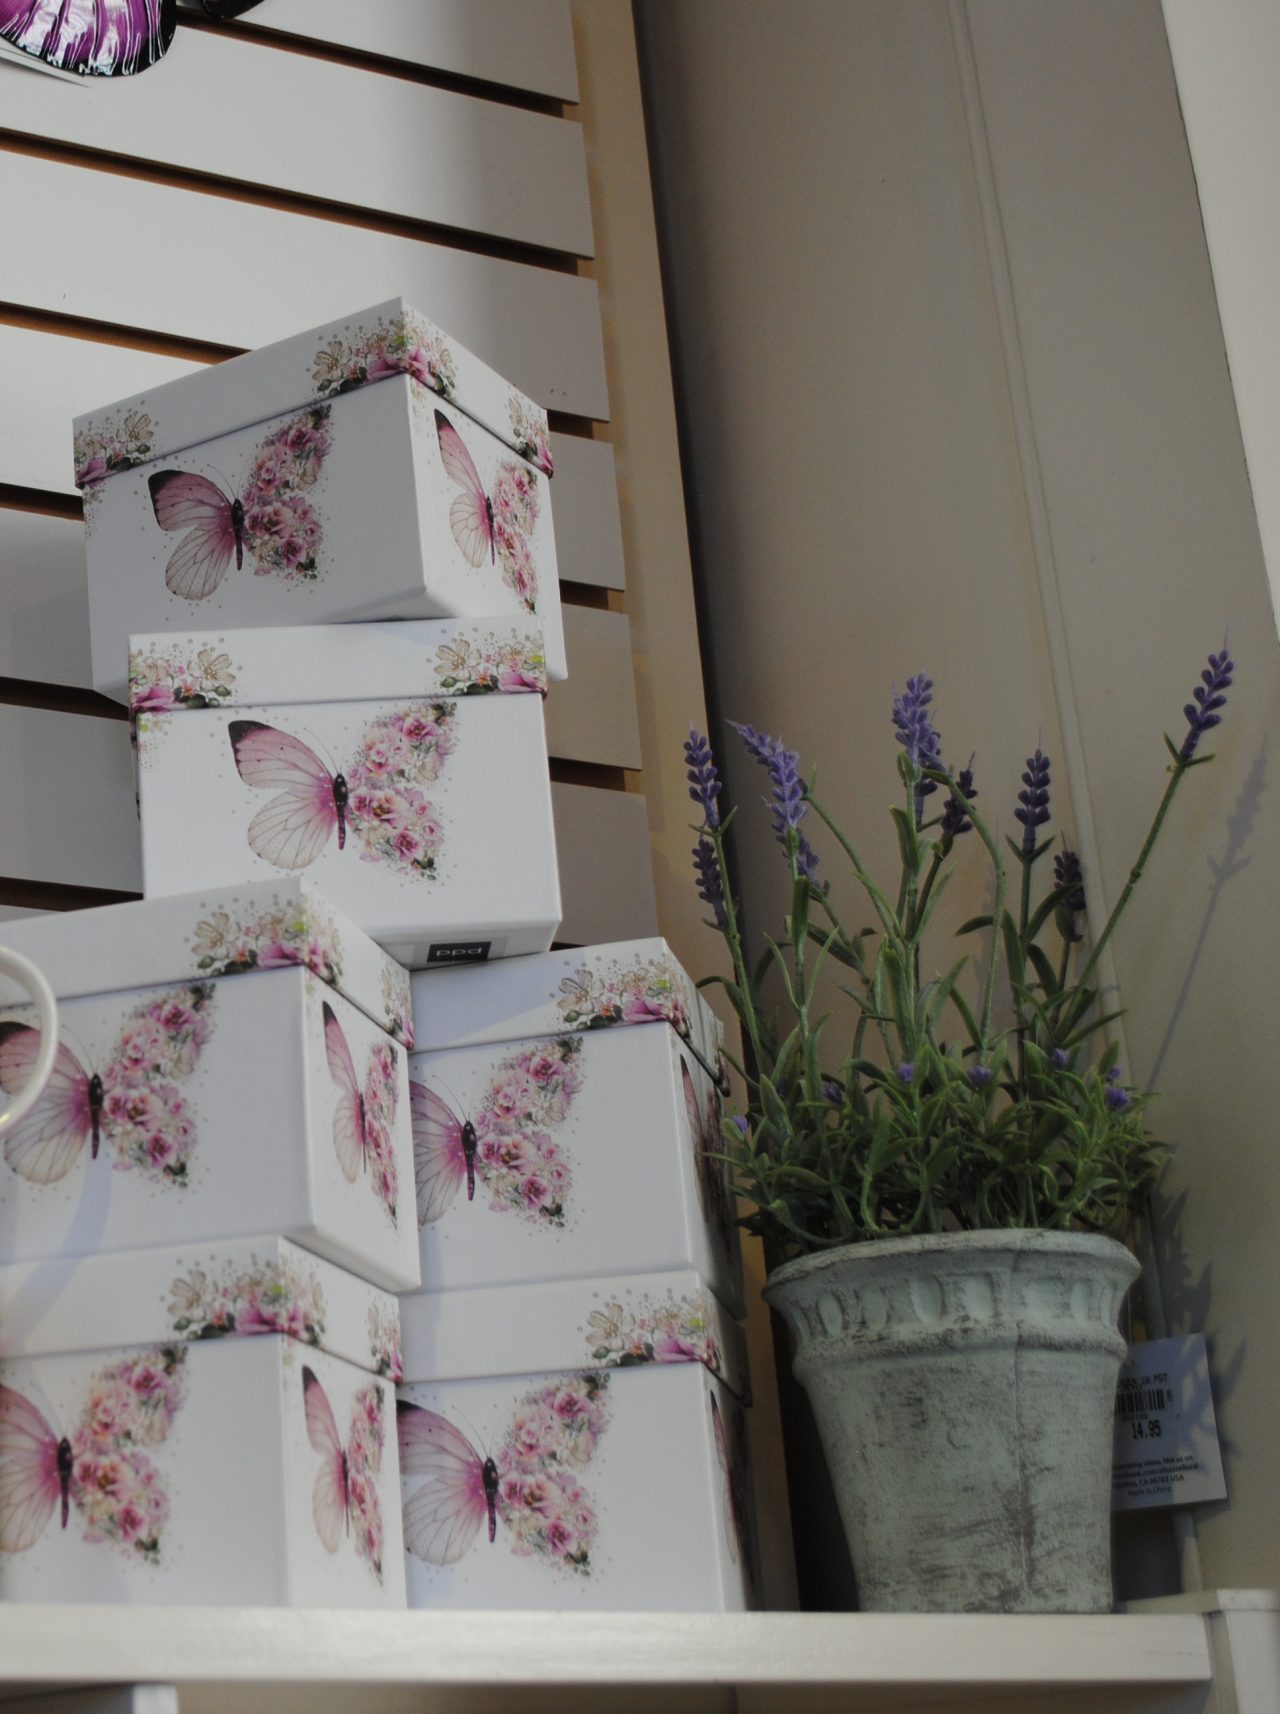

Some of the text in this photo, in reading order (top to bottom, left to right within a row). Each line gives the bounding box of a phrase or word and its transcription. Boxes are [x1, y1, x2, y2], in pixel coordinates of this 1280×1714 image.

[436, 947, 482, 956] ppd
[1131, 1419, 1162, 1440] 14.95
[1163, 1455, 1174, 1464] like
[1139, 1478, 1149, 1486] CA
[1170, 1473, 1185, 1482] USA
[1128, 1489, 1145, 1497] Made
